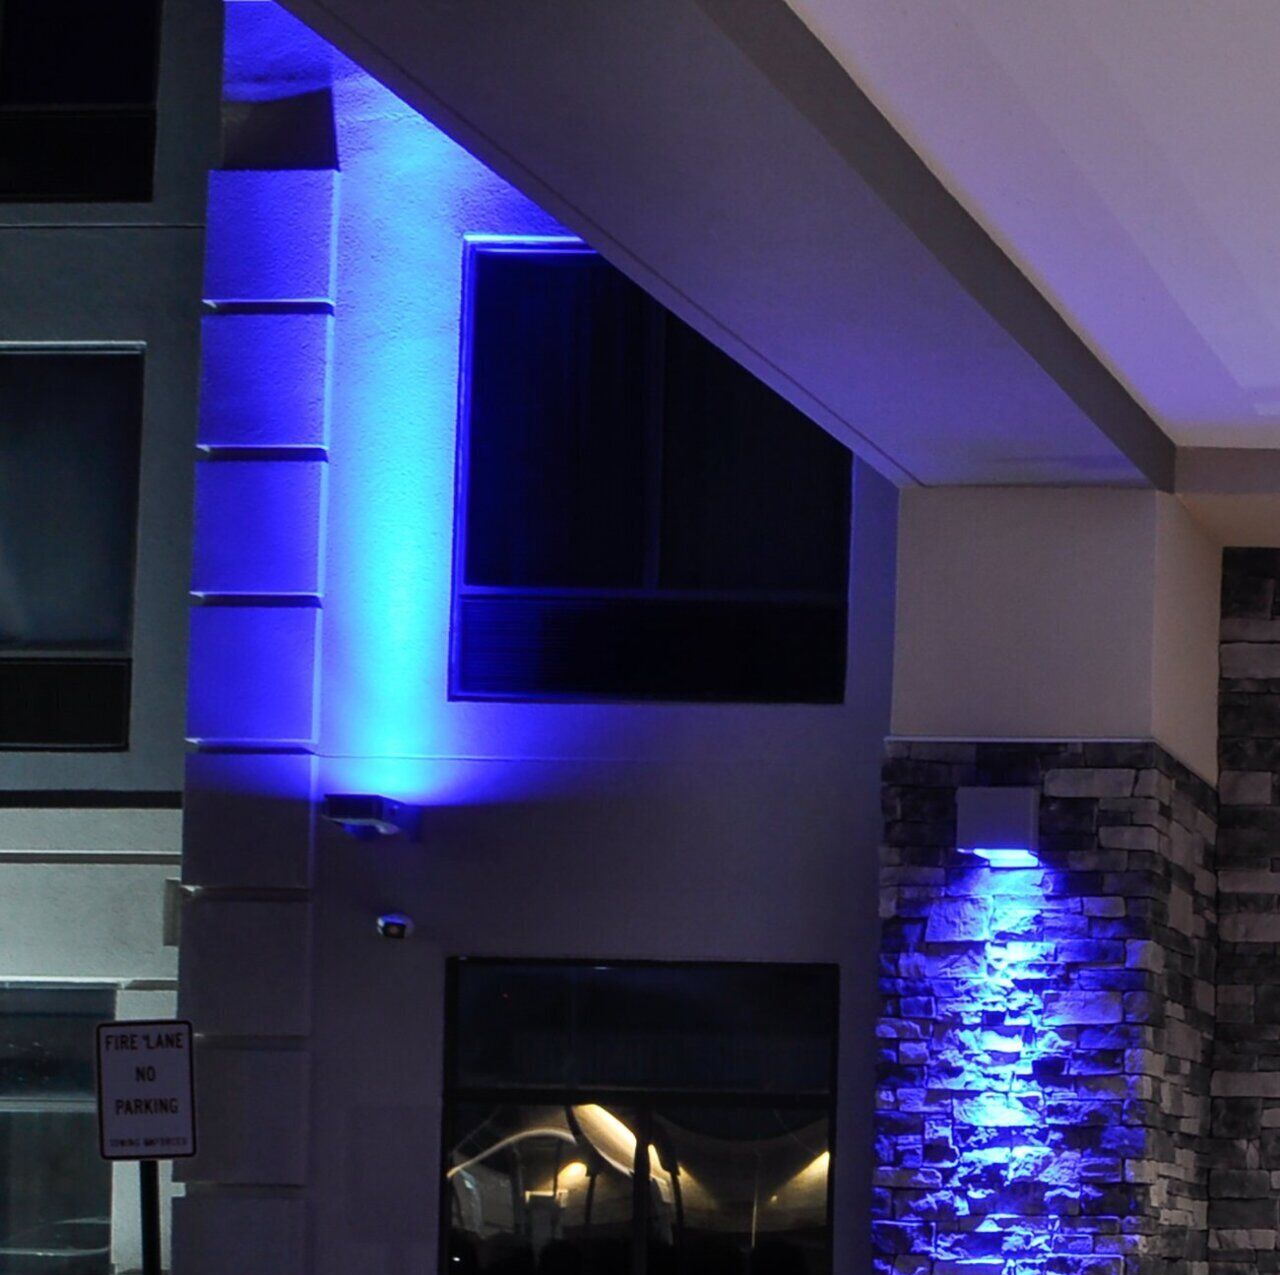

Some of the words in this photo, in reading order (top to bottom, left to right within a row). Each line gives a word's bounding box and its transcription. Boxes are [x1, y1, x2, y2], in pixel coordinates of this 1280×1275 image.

[105, 1034, 138, 1050] FIRE
[145, 1033, 184, 1049] LANE
[135, 1066, 156, 1082] NO
[115, 1098, 179, 1115] PARKING
